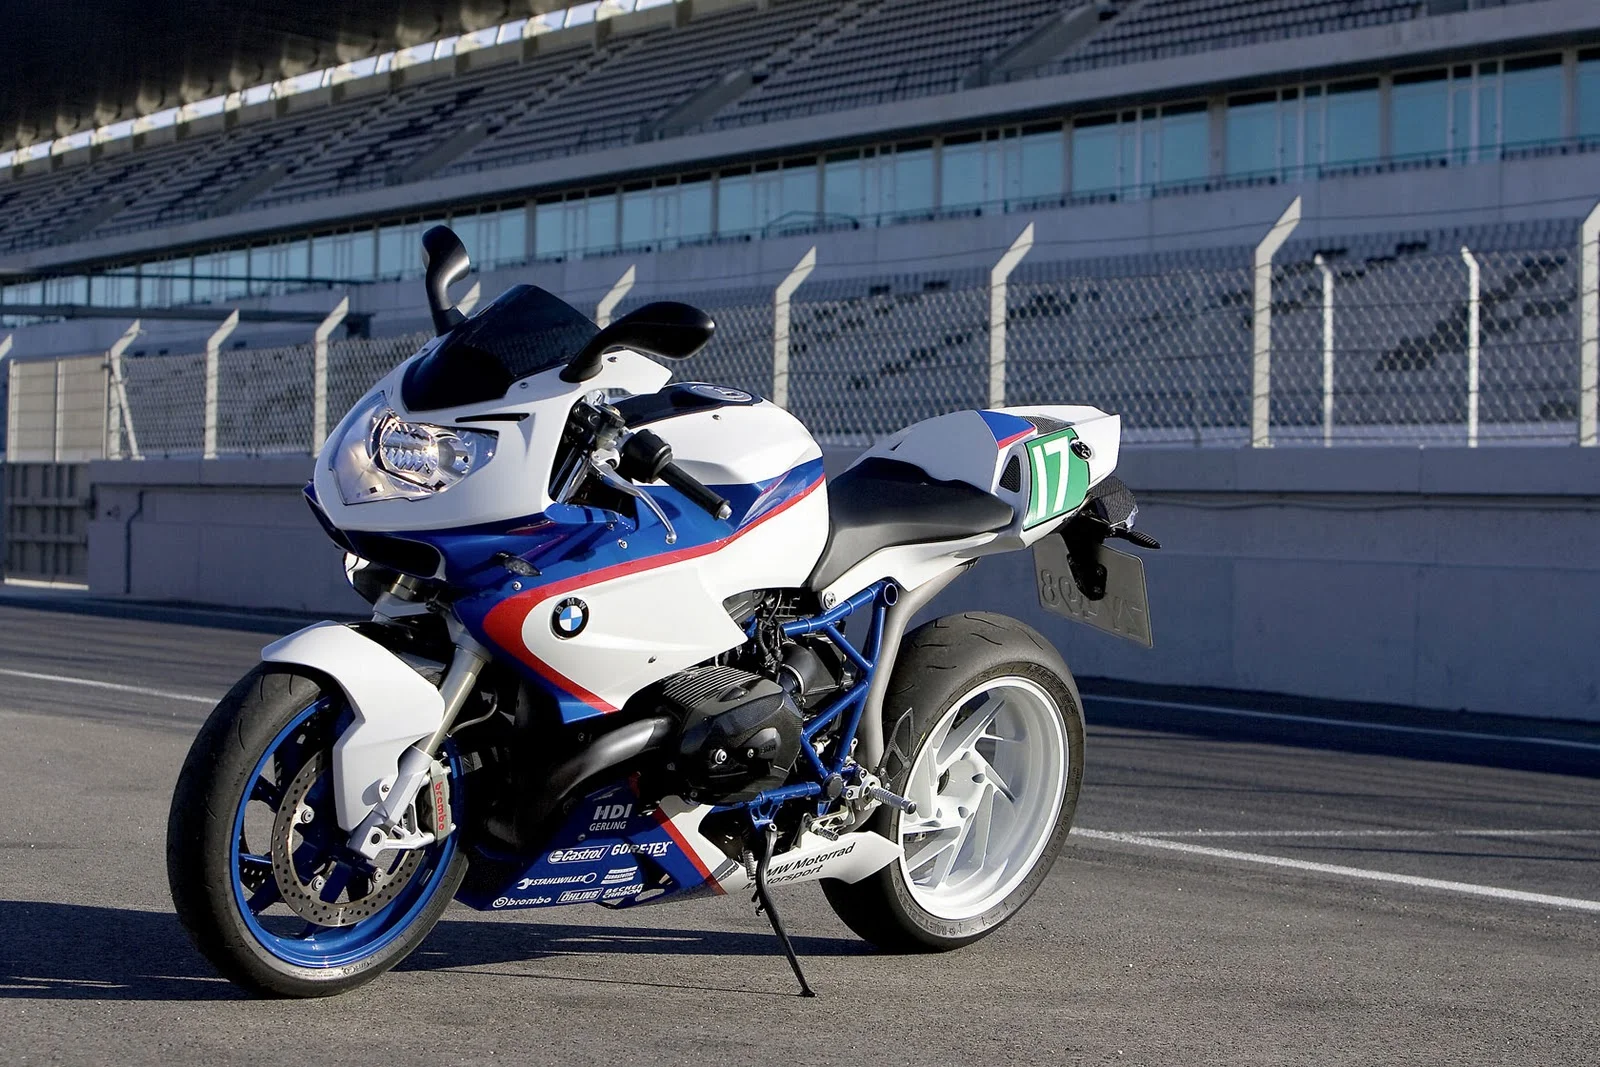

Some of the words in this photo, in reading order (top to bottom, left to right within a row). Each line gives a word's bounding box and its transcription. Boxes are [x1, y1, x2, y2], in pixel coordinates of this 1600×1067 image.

[1032, 436, 1069, 520] 17
[555, 597, 587, 614] BMW
[435, 782, 446, 831] brembo
[593, 803, 633, 820] HDI
[589, 821, 627, 831] GERLING
[562, 847, 605, 861] Castrol
[766, 862, 795, 877] MW
[794, 842, 856, 871] Motorrad
[530, 874, 587, 886] STAHLWILLE
[507, 896, 552, 906] brembo
